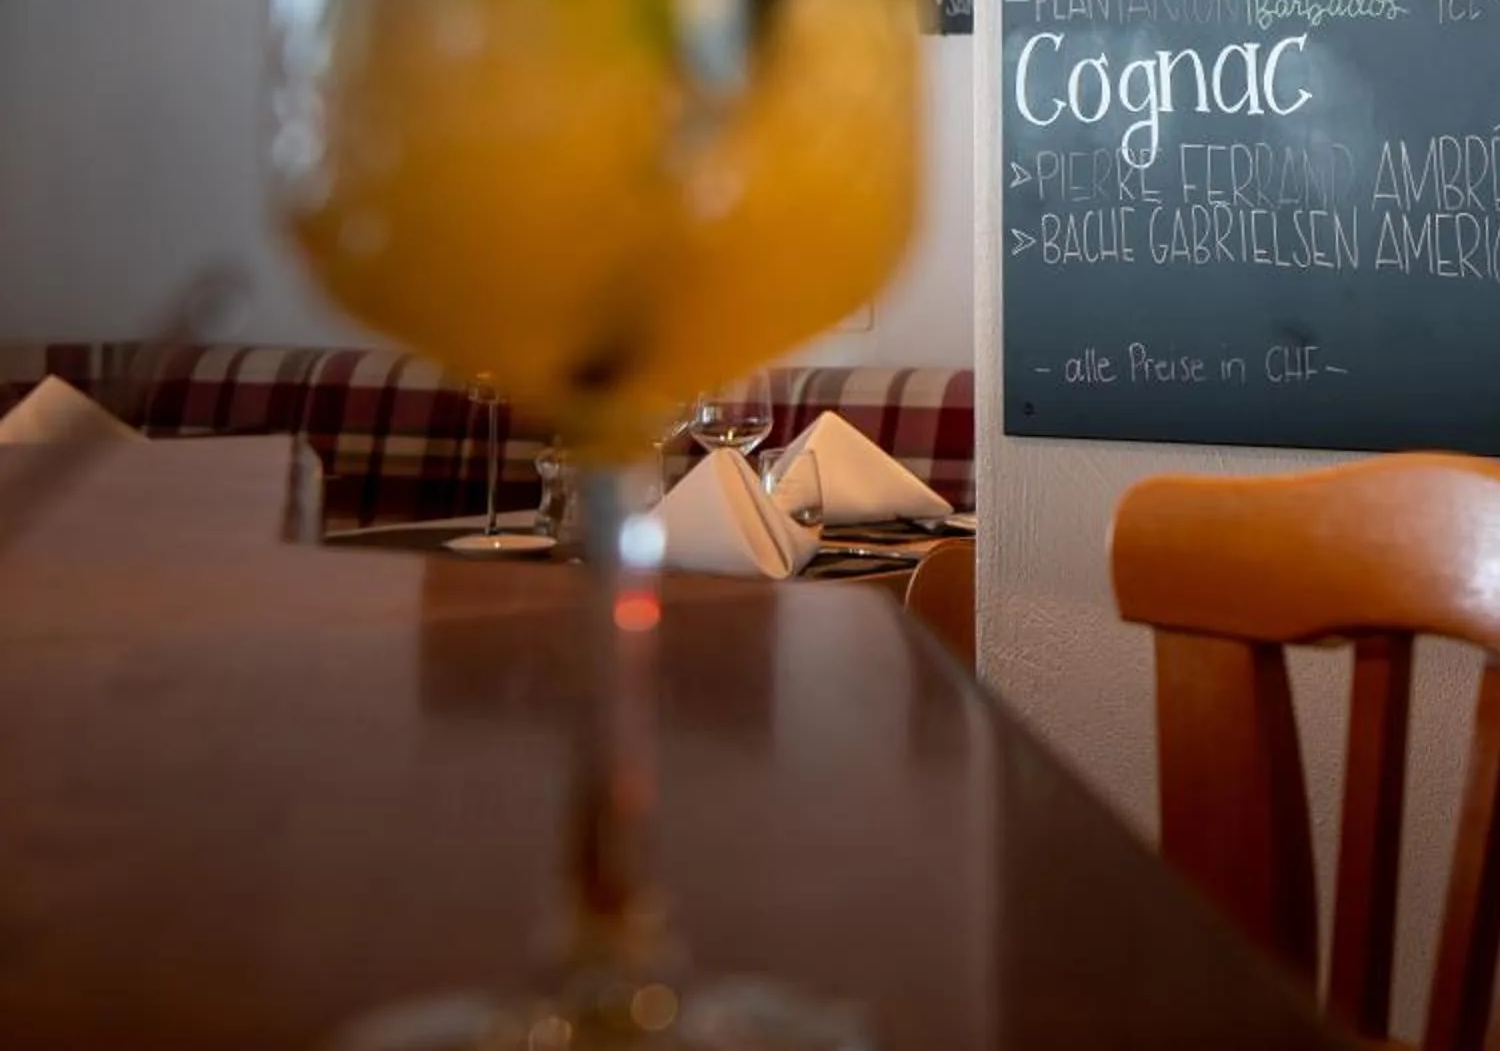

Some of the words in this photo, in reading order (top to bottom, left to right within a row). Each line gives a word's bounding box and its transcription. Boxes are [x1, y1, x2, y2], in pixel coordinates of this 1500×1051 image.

[1014, 30, 1313, 170] Cognac
[1041, 206, 1135, 265] BACHE
[1149, 201, 1359, 271] GABRIELSEN
[1064, 347, 1118, 383] alle
[1128, 342, 1205, 382] Preise
[1221, 351, 1246, 384] in
[1265, 346, 1320, 383] CHF
